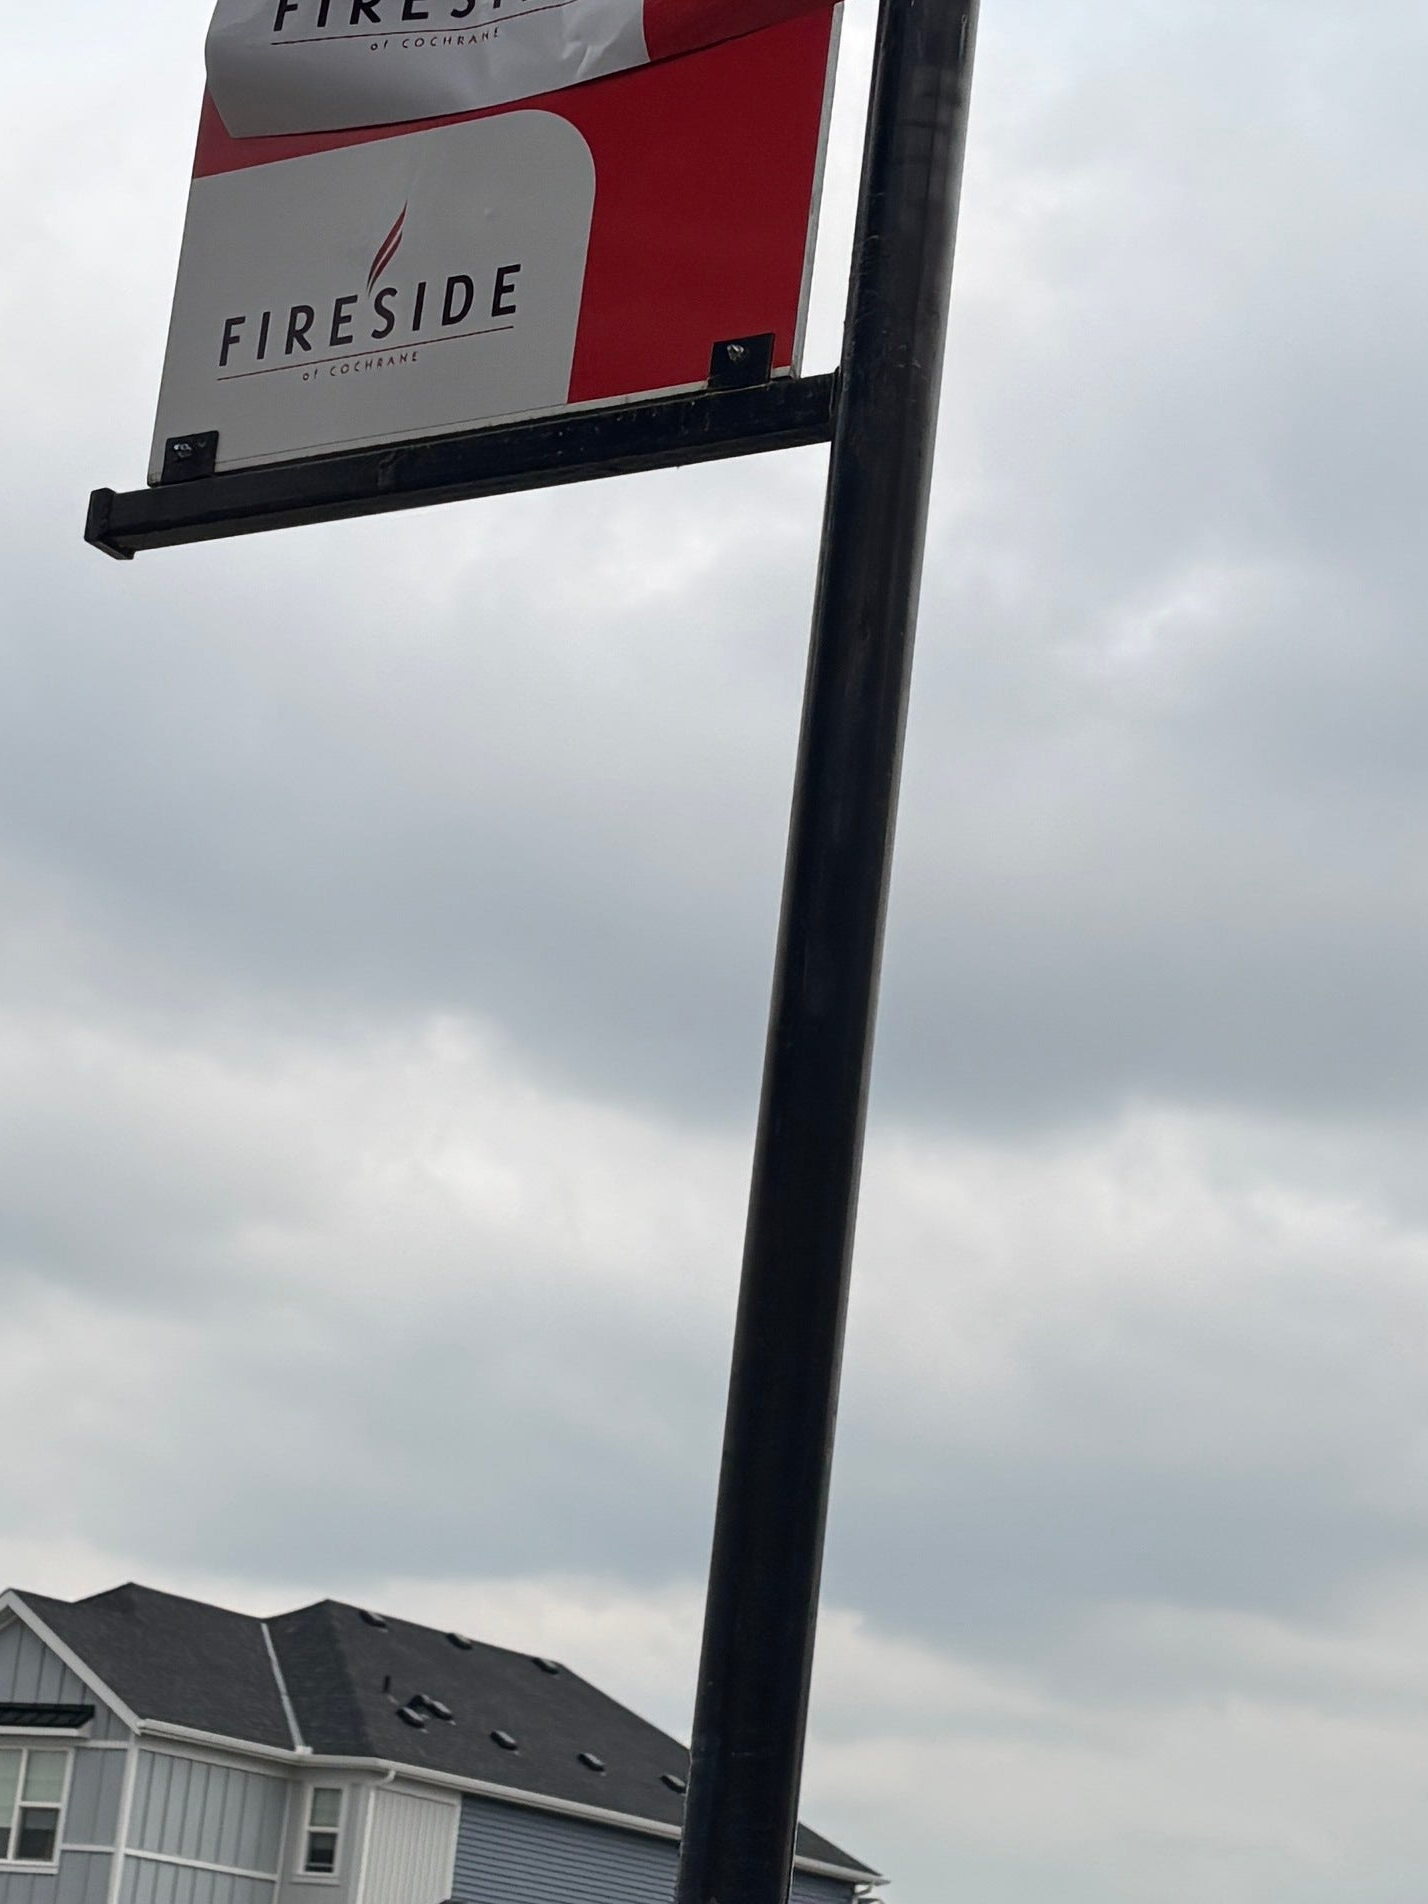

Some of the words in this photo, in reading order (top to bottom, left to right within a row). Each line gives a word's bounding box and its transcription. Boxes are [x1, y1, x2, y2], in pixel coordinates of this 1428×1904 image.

[401, 27, 500, 49] COCHRANE
[218, 264, 522, 367] FIRESIDE
[329, 351, 420, 377] COCHRANE
